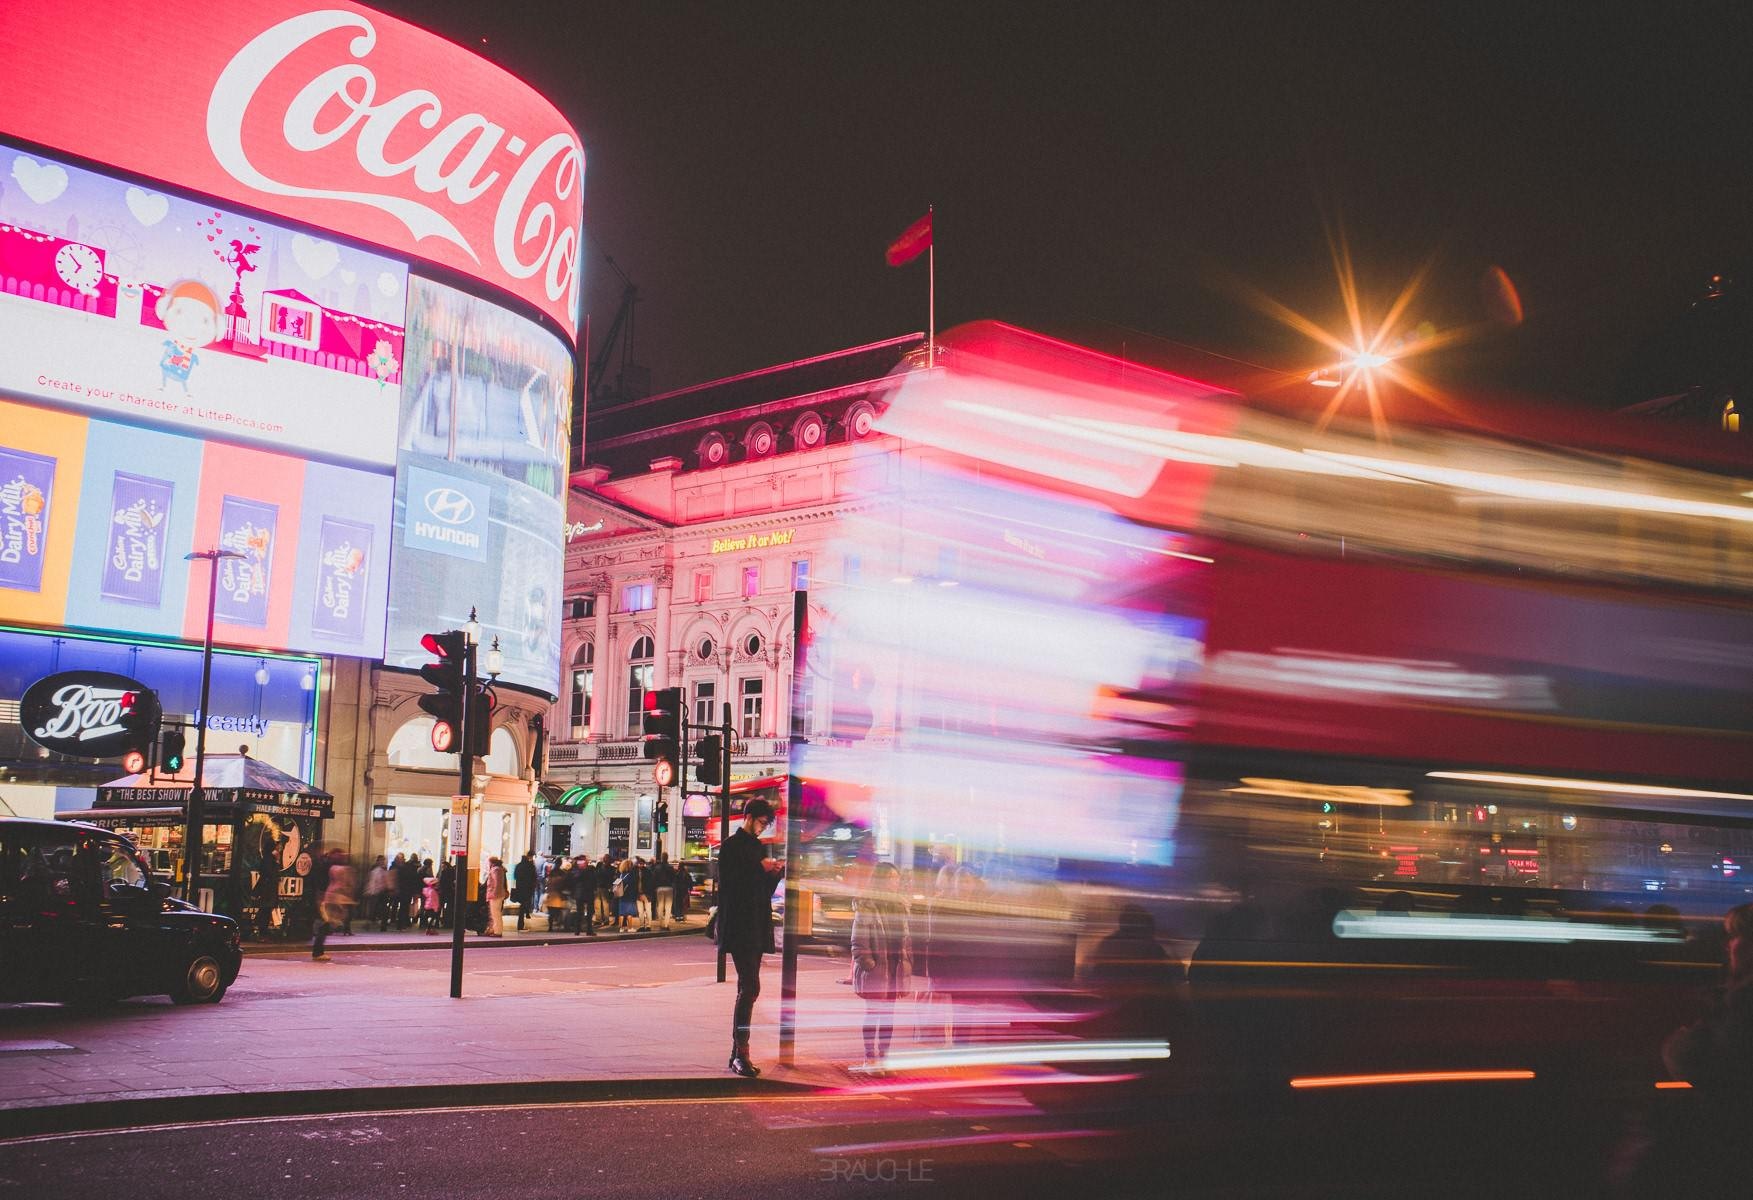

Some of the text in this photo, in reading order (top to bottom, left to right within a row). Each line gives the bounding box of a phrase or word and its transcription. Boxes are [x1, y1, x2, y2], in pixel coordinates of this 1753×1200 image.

[37, 375, 82, 393] Create
[87, 386, 114, 398] your
[118, 392, 178, 412] character
[182, 406, 194, 415] at
[0, 474, 27, 563] Dairy Milk
[415, 521, 480, 548] HYUNDAI
[124, 498, 147, 583] Dairy Milk
[712, 538, 747, 553] Believe
[746, 533, 758, 549] It
[757, 535, 770, 547] or
[233, 558, 253, 603] Dairy
[333, 577, 352, 619] Dairy
[34, 684, 140, 741] Boo
[136, 789, 157, 801] BEST
[158, 789, 182, 801] SHOW
[256, 805, 271, 813] HALF
[272, 805, 289, 814] PRICE
